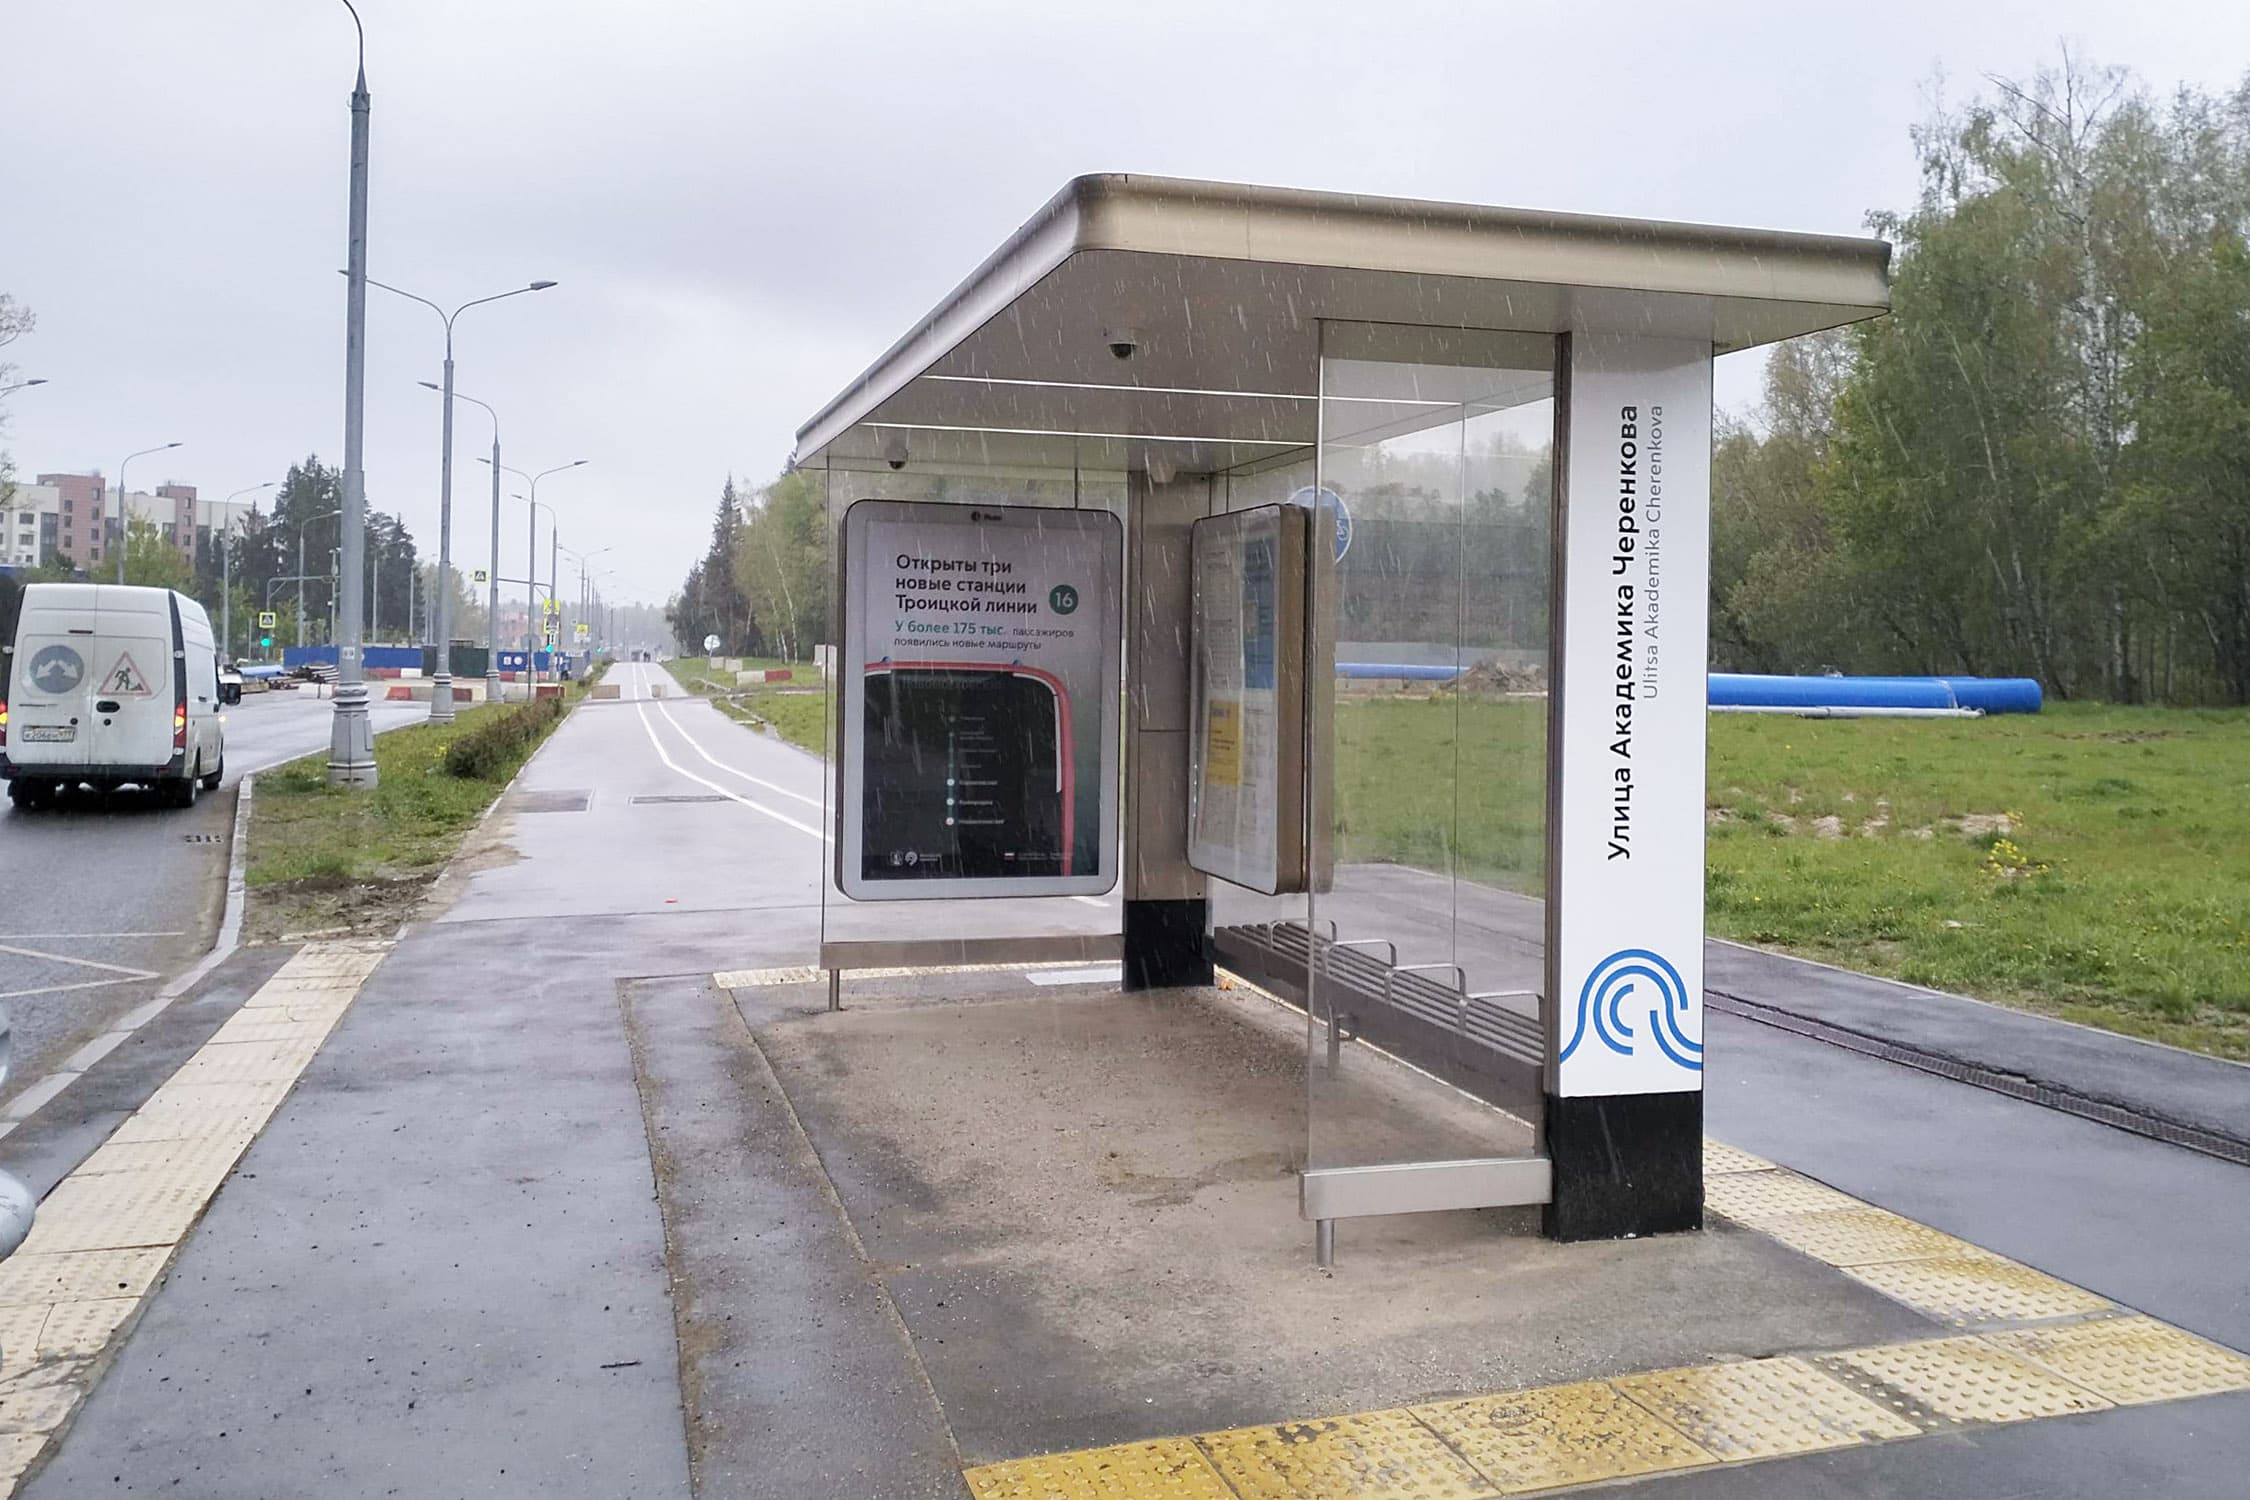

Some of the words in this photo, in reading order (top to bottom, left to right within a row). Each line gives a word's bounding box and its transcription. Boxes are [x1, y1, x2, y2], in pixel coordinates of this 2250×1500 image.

[1646, 406, 1663, 522] Cherenkova
[1612, 406, 1640, 575] Черенкова
[896, 554, 977, 573] Открыты
[981, 562, 1012, 576] три
[1644, 529, 1660, 639] Akademika
[895, 577, 951, 591] новые
[956, 580, 1026, 594] станции
[896, 594, 981, 613] Троицкой
[985, 602, 1037, 614] линии
[1055, 592, 1074, 607] 16
[894, 638, 949, 648] появились
[952, 641, 985, 649] новые
[988, 642, 1042, 651] маршруты
[895, 620, 904, 633] У
[907, 620, 949, 634] более
[953, 622, 976, 635] 175
[1013, 628, 1074, 638] пассажиров
[1610, 584, 1635, 759] Академика
[1643, 645, 1658, 699] Ulitsa
[1608, 767, 1634, 860] Улица
